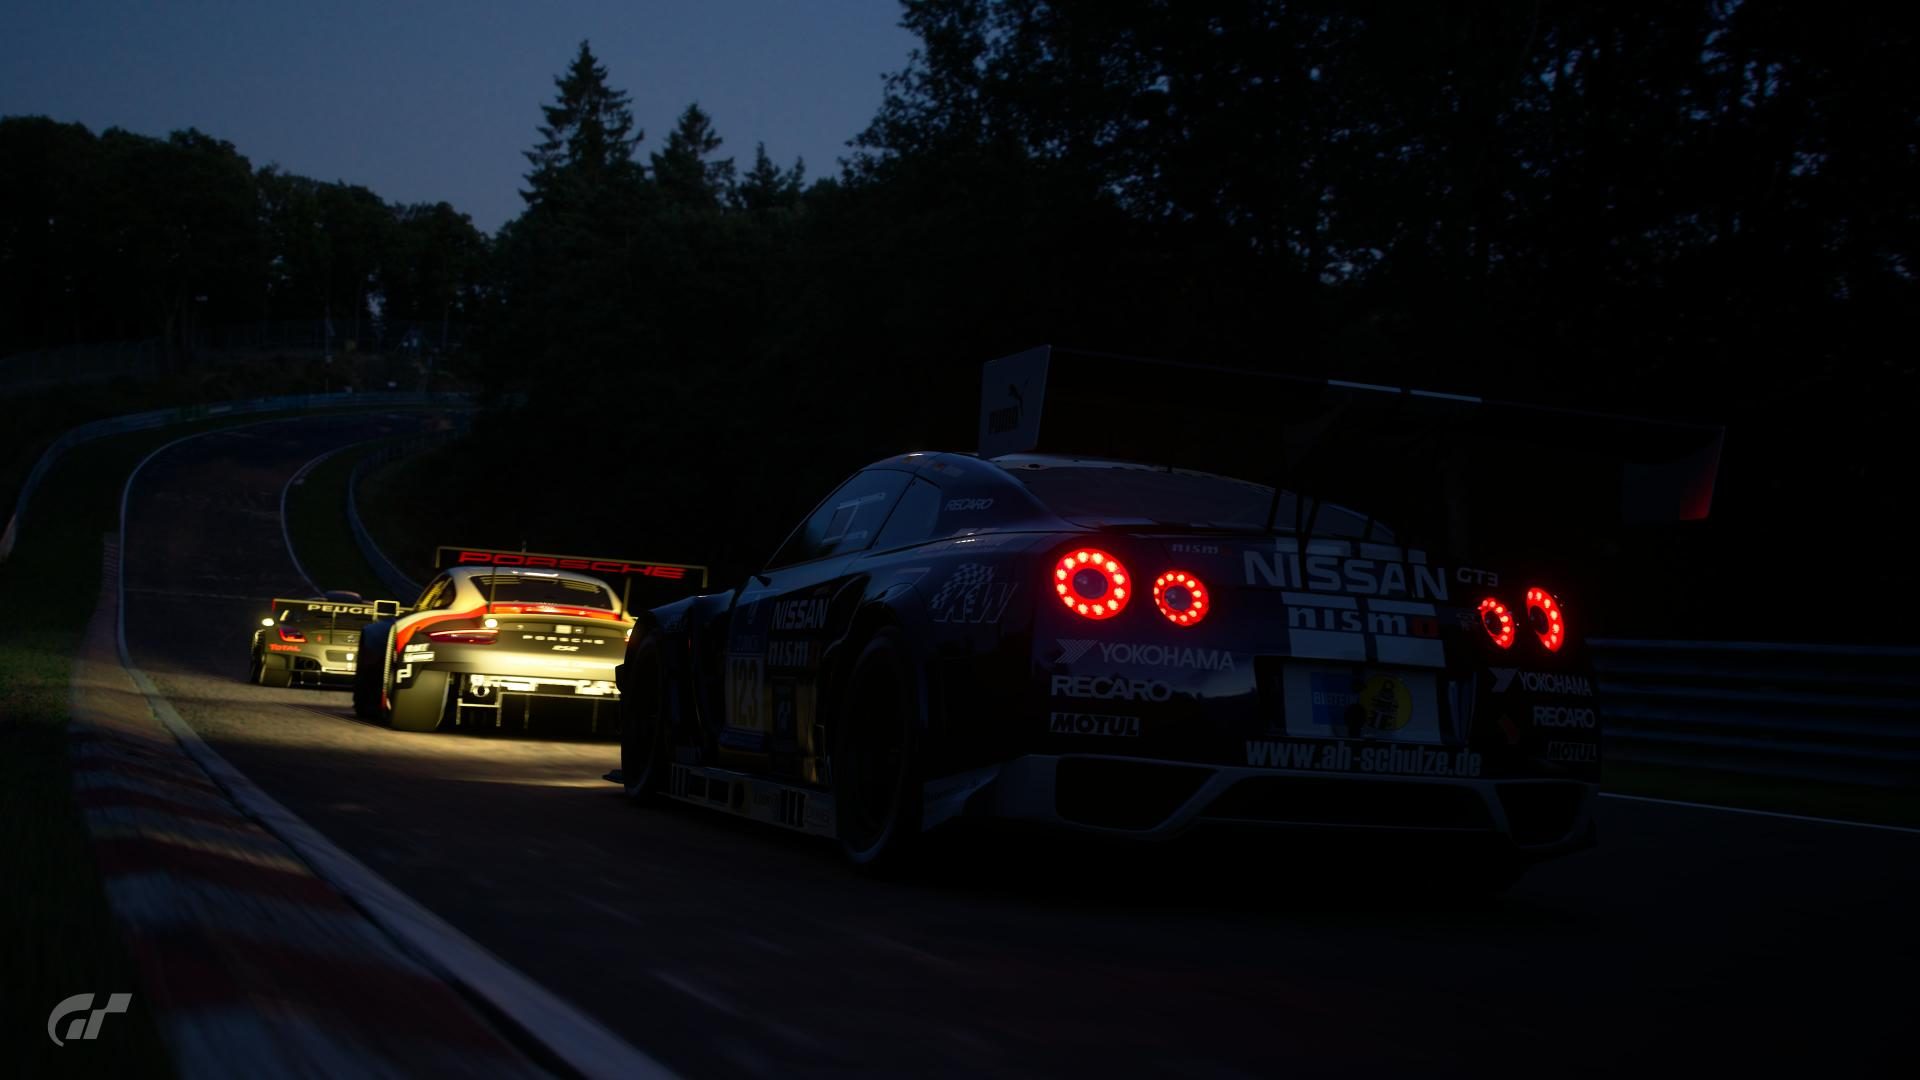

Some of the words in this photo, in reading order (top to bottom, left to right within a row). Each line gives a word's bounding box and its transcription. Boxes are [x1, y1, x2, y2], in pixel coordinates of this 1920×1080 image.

[944, 497, 994, 512] RECARO
[457, 550, 688, 580] PORSCHE
[1243, 550, 1449, 601] NISSAN
[1455, 566, 1499, 588] GT3
[307, 603, 405, 617] PEUGE
[771, 597, 831, 631] NISSAN
[1099, 641, 1236, 672] YOKOHAMA
[1051, 676, 1173, 702] RECARO
[1518, 671, 1593, 696] YOKOHAMA
[1052, 713, 1140, 736] MOTUL
[1532, 704, 1596, 729] RECARO
[1246, 740, 1483, 777] www.ah-schulze.de
[1549, 742, 1597, 761] MOTUL
